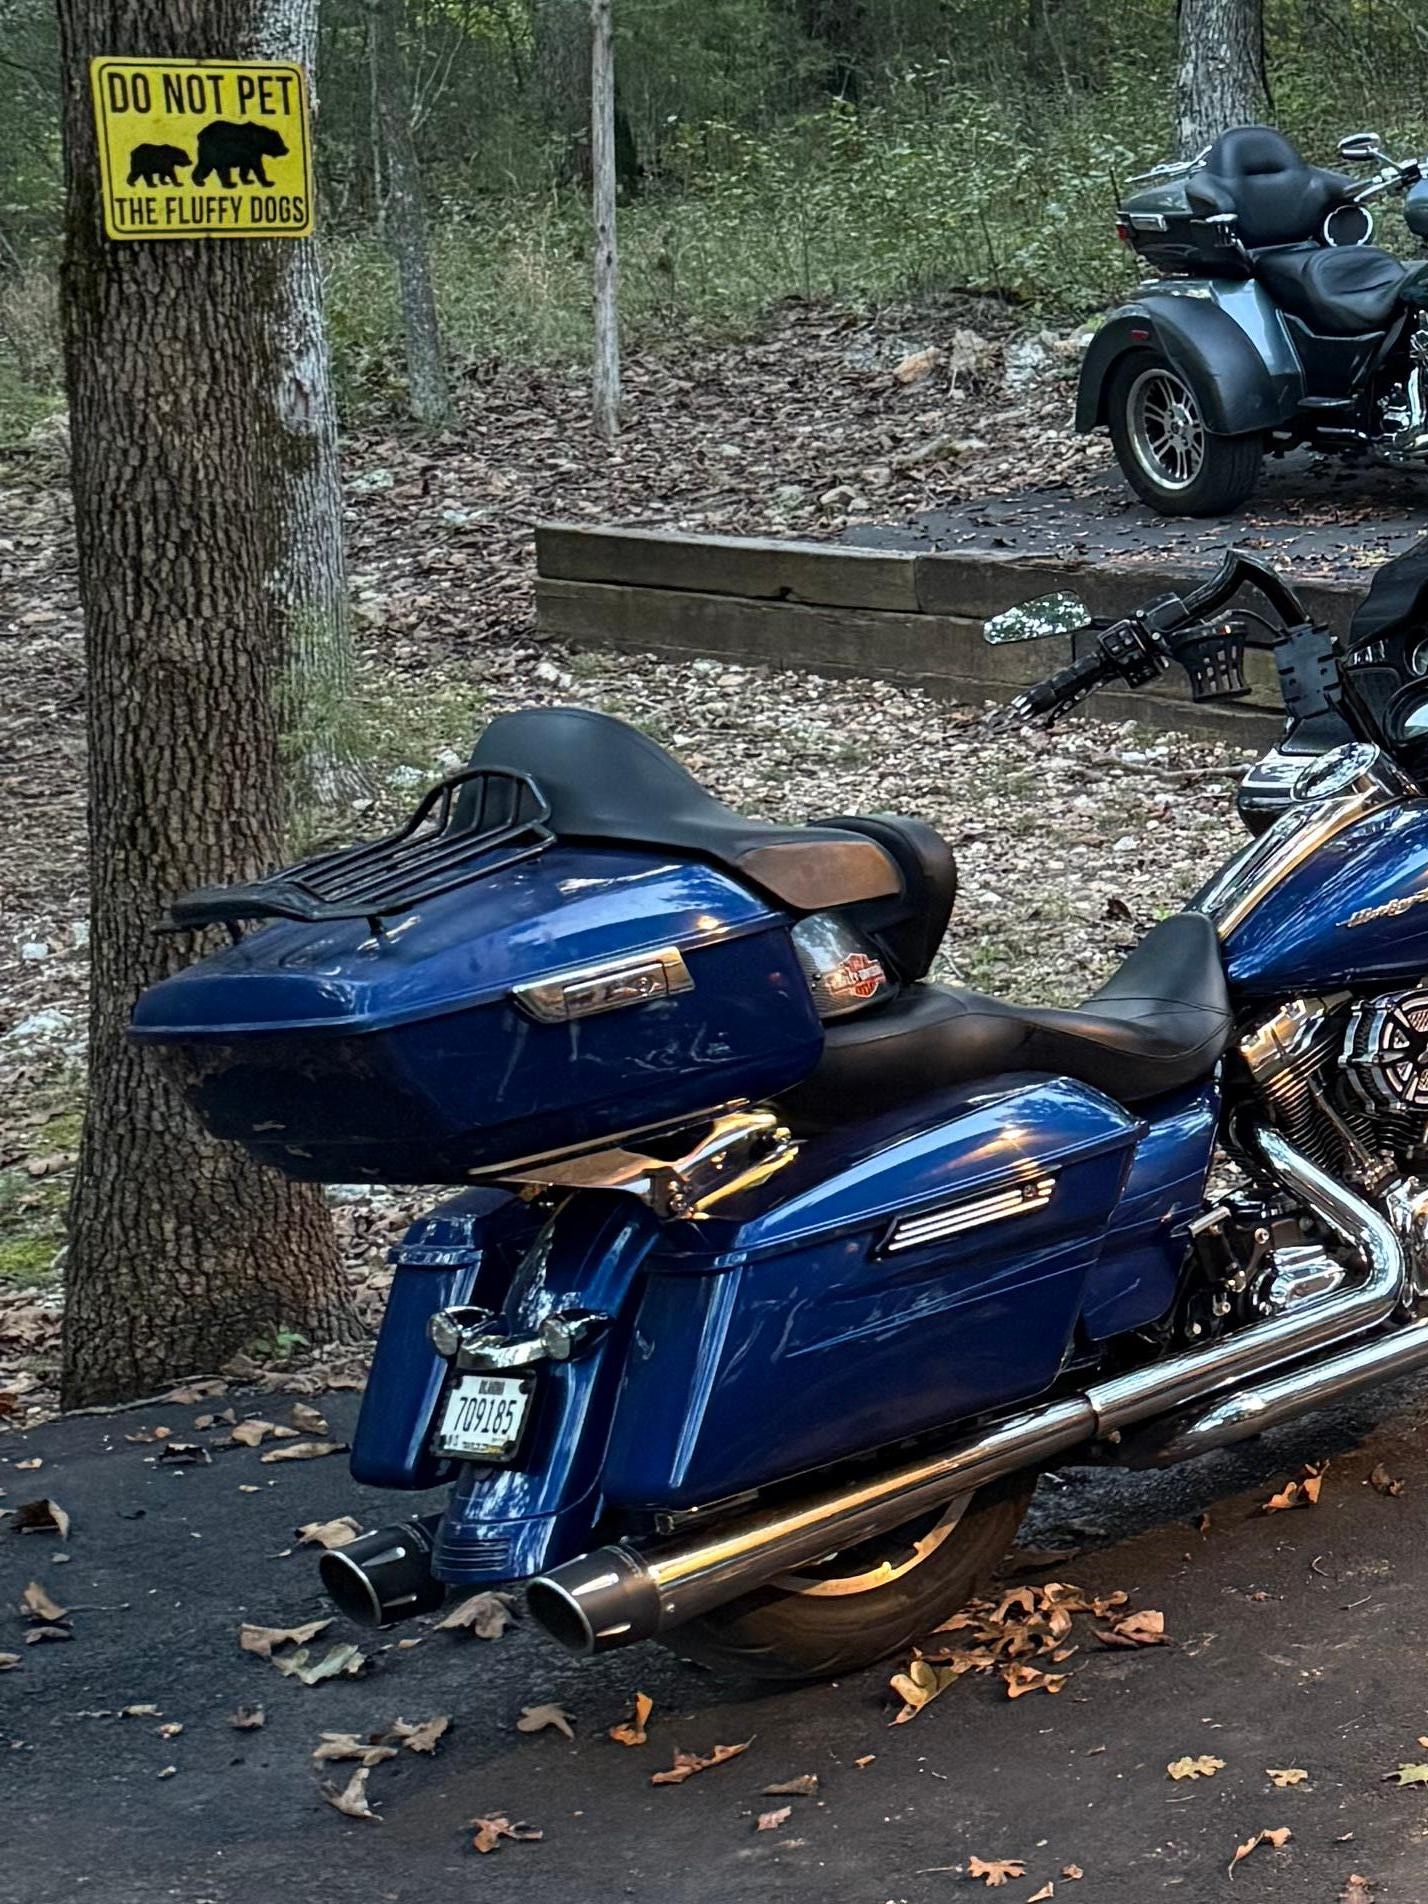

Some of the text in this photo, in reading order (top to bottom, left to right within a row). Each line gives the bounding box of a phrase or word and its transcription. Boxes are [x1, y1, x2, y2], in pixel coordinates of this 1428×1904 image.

[107, 72, 294, 116] DO NOT PET
[114, 195, 305, 226] THE FLUFFY DOGS
[453, 1396, 518, 1435] 709185
